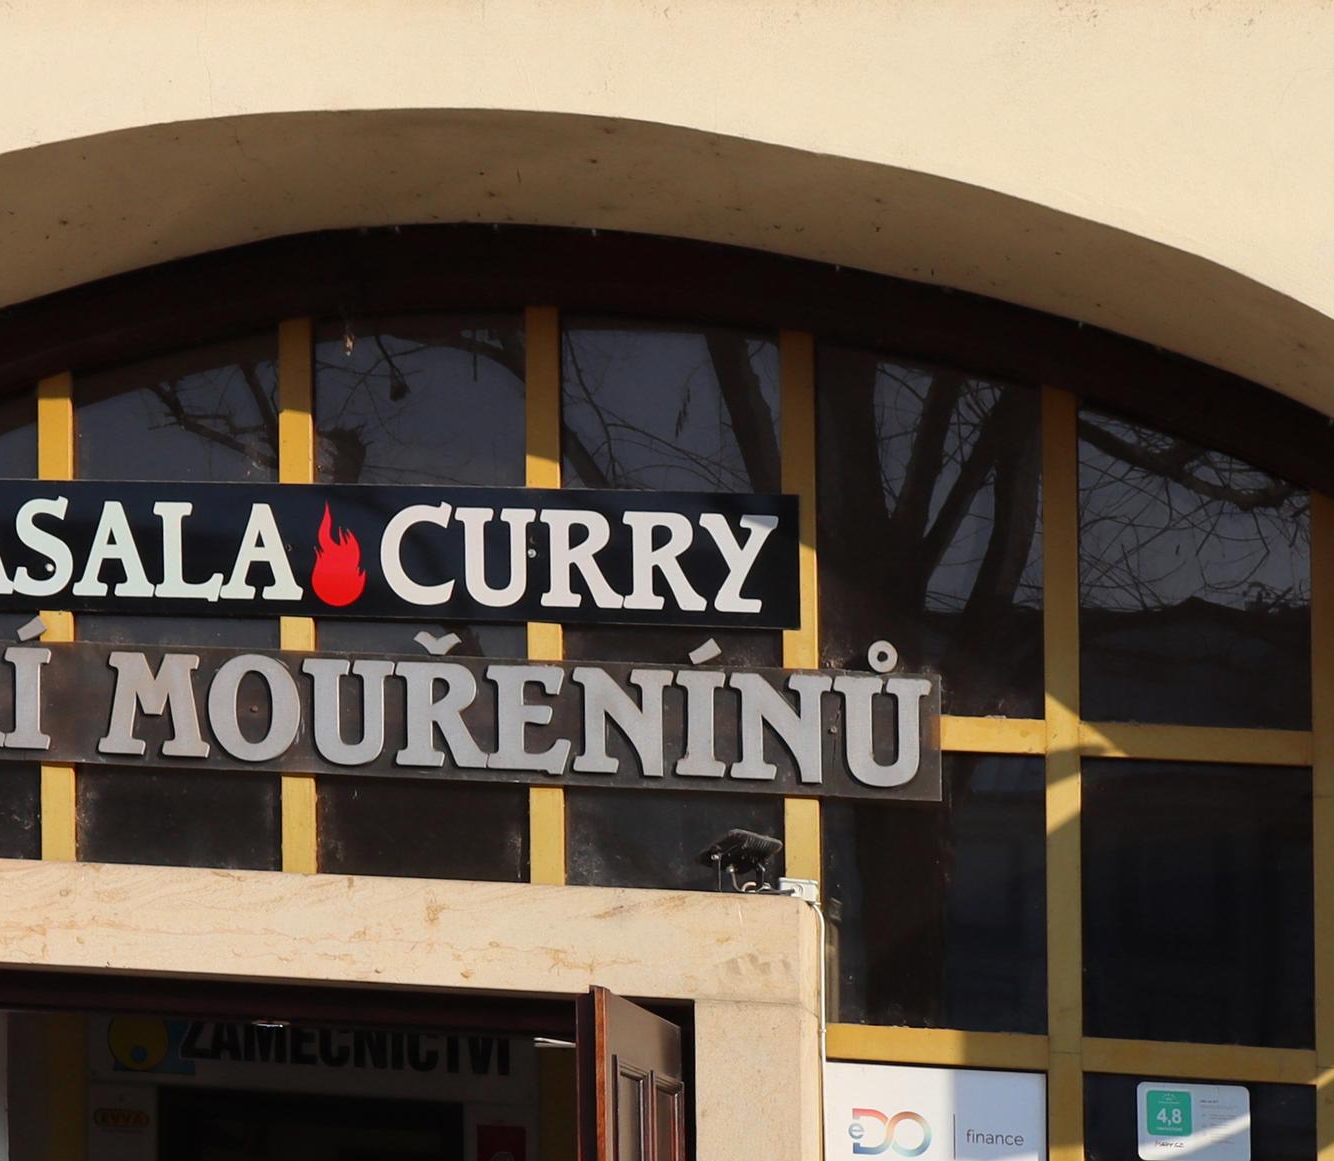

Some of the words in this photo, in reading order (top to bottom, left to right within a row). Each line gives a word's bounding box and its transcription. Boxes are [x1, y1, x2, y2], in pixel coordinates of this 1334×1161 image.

[380, 502, 779, 613] CURRY
[97, 631, 933, 788] MOUŘENÍNŮ
[966, 1129, 1025, 1147] finance
[1157, 1108, 1182, 1126] 4,8
